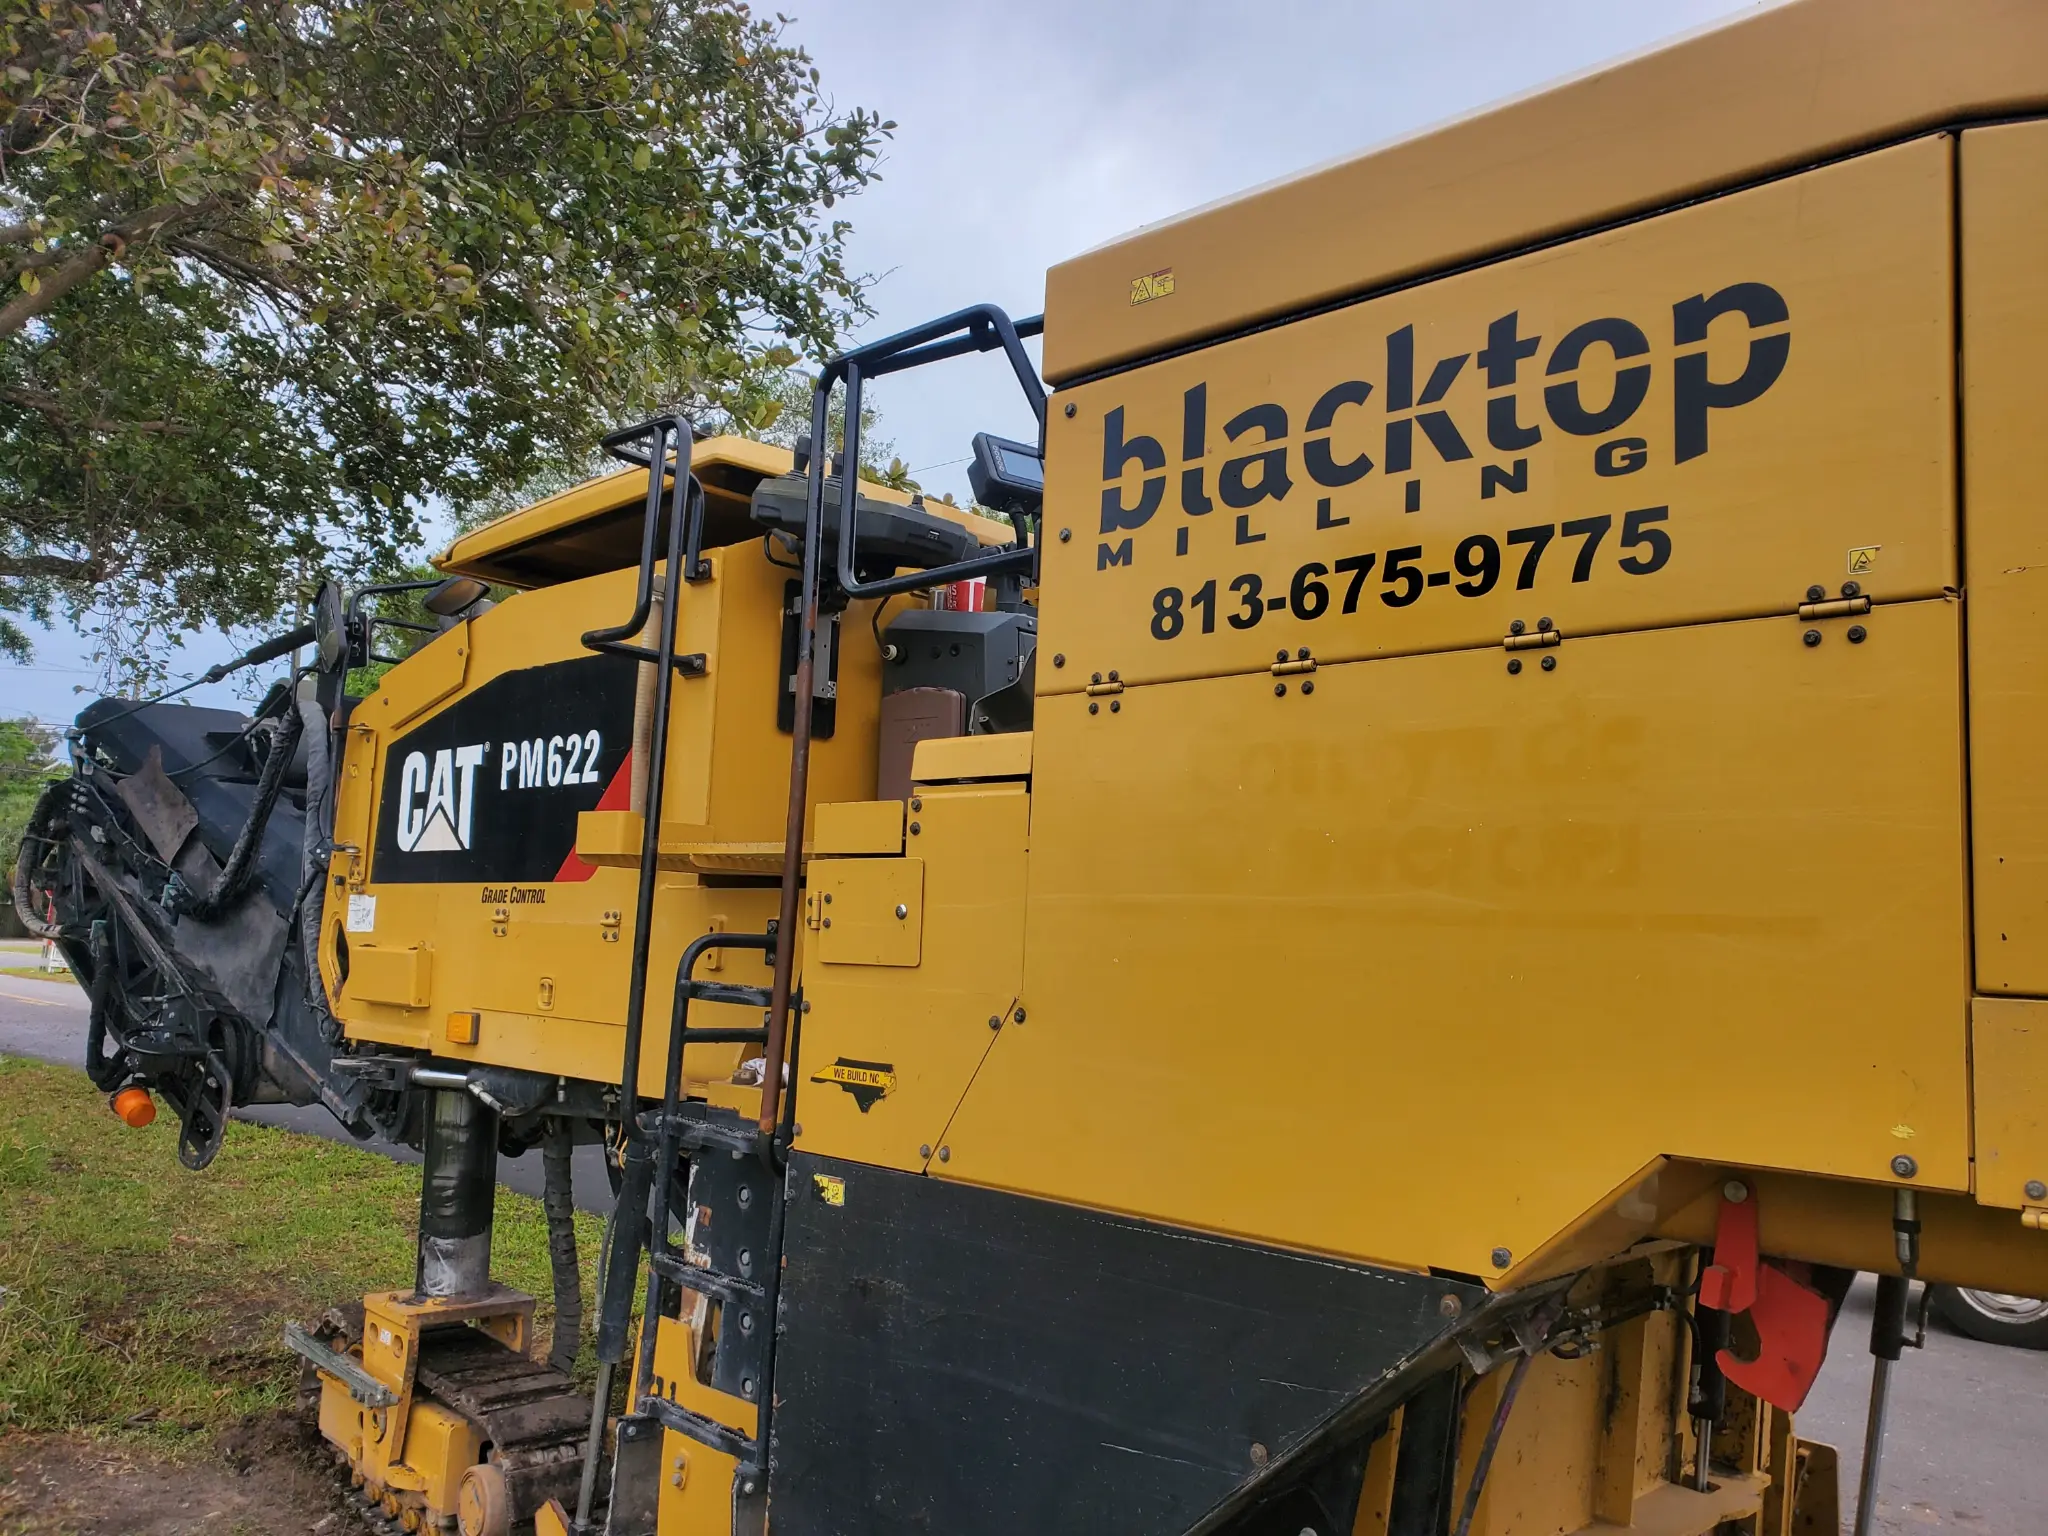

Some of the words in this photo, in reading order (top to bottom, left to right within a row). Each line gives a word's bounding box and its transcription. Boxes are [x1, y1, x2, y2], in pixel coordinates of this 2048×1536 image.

[1099, 282, 1791, 534] blacktop
[1096, 437, 1647, 571] MILLING
[1150, 505, 1671, 641] 813-675-9775
[397, 744, 484, 852] CAT
[500, 729, 600, 791] PM622
[833, 1067, 845, 1079] WE
[847, 1069, 867, 1082] BUILD
[869, 1072, 880, 1084] NC
